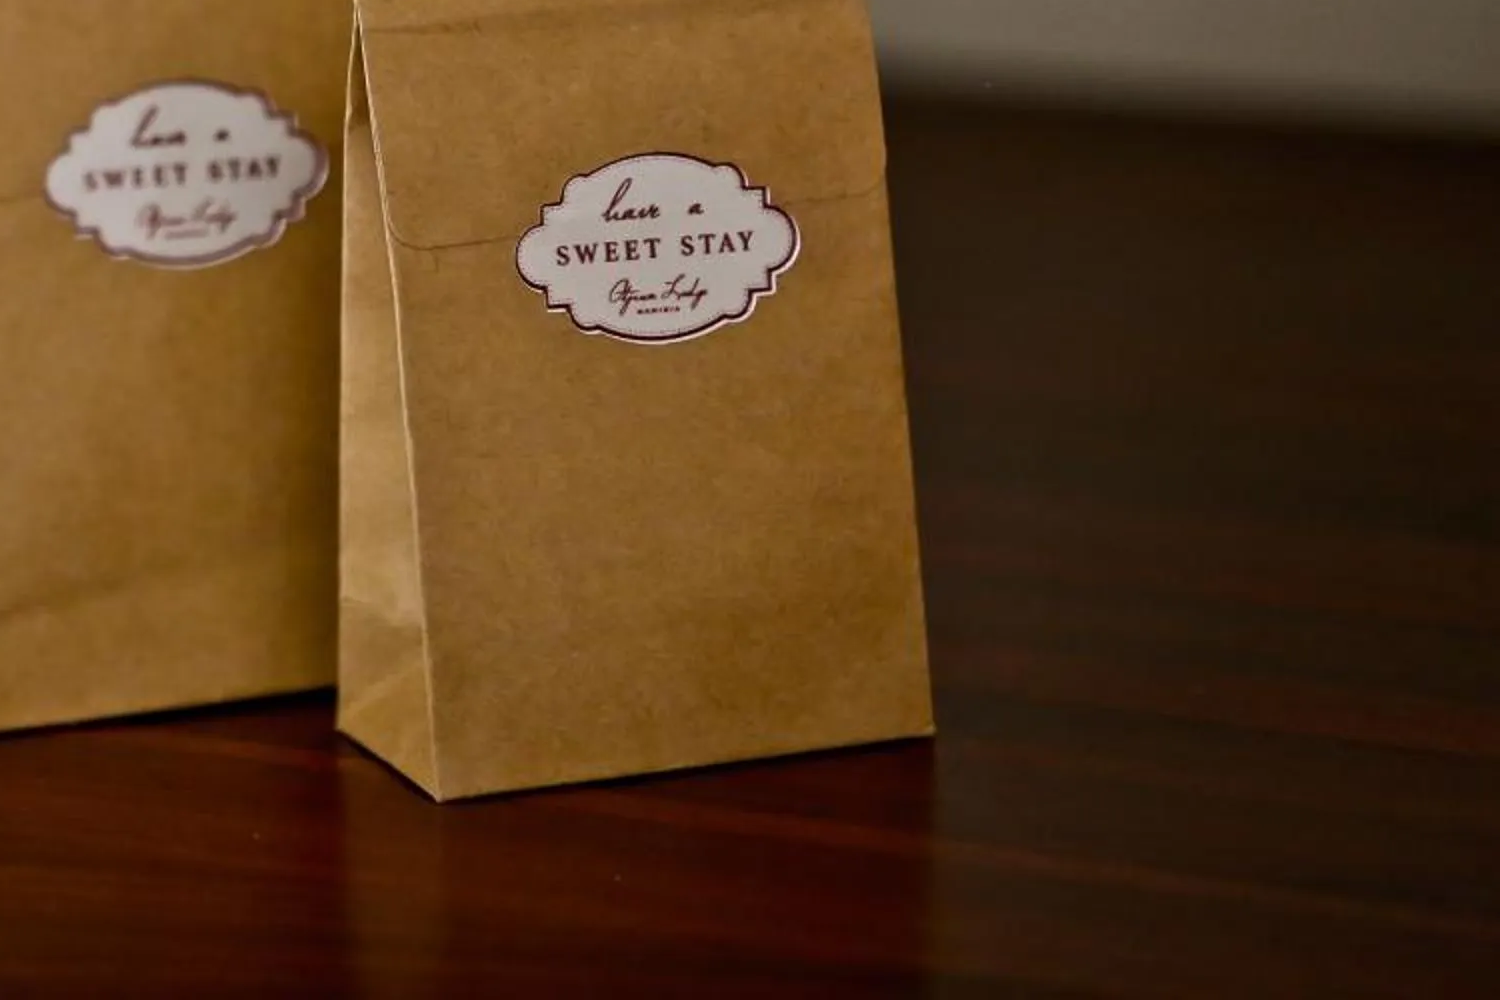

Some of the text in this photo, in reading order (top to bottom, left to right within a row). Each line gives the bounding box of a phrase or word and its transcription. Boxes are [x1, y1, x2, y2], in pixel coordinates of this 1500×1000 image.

[82, 154, 282, 193] SWEET STAY
[602, 178, 705, 222] have a
[556, 231, 755, 266] SWEET STAY
